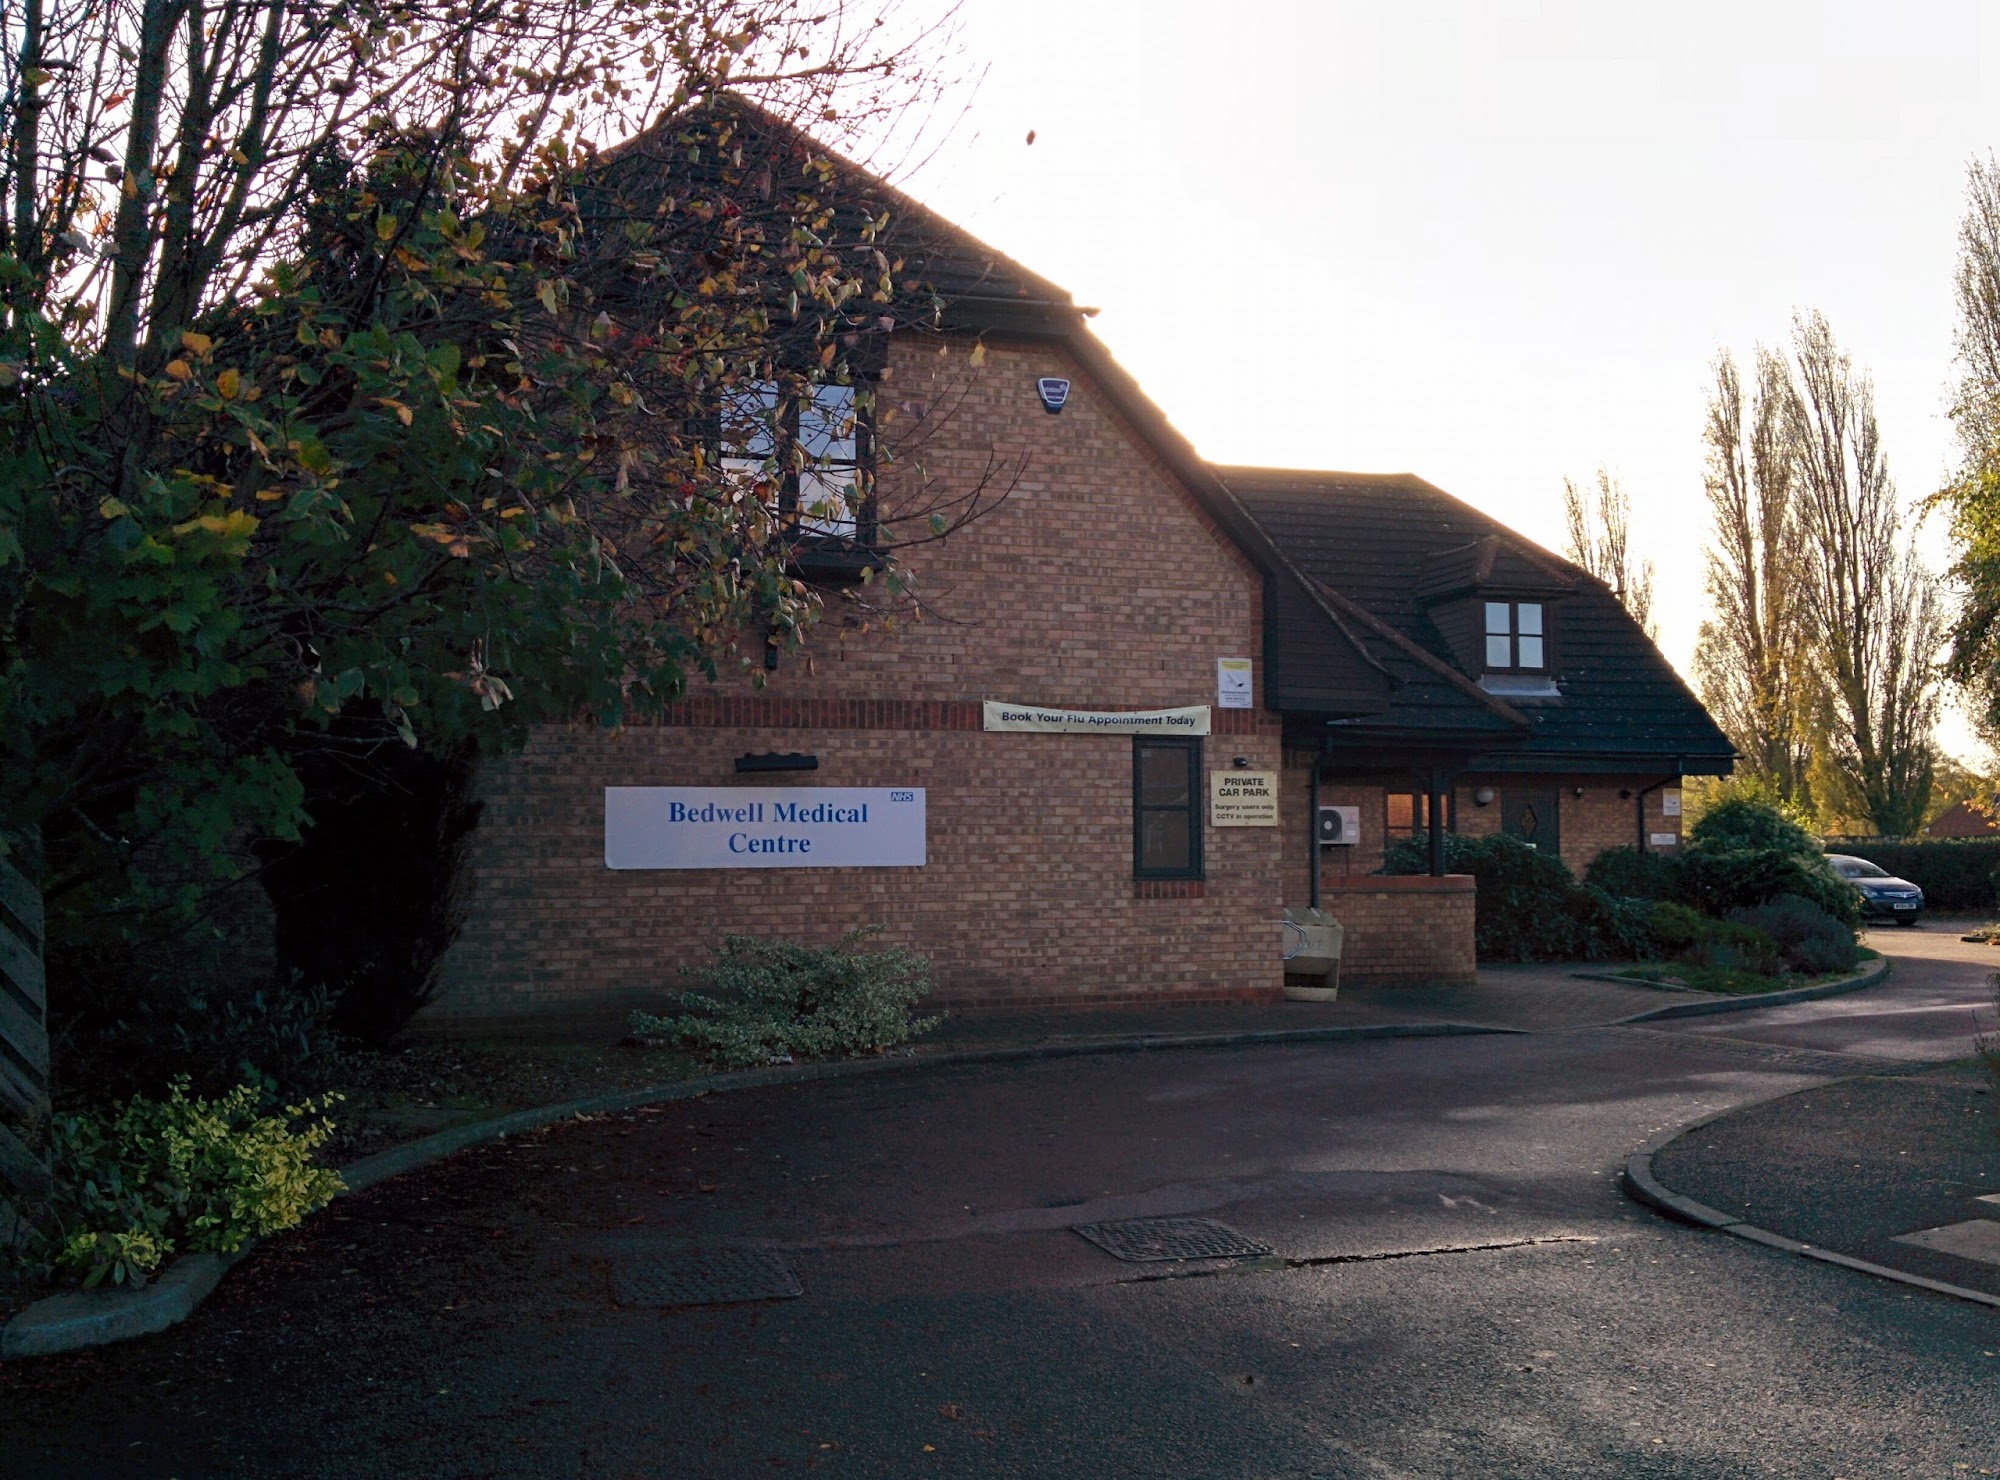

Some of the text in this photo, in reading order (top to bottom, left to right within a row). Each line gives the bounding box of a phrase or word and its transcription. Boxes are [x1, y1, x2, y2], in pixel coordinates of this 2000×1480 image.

[1002, 712, 1196, 727] Book Your Flu Appointment Today
[1224, 778, 1264, 786] PRIVATE
[891, 792, 914, 802] NHS
[668, 802, 868, 823] Bedwell Medical
[729, 833, 811, 853] Centre
